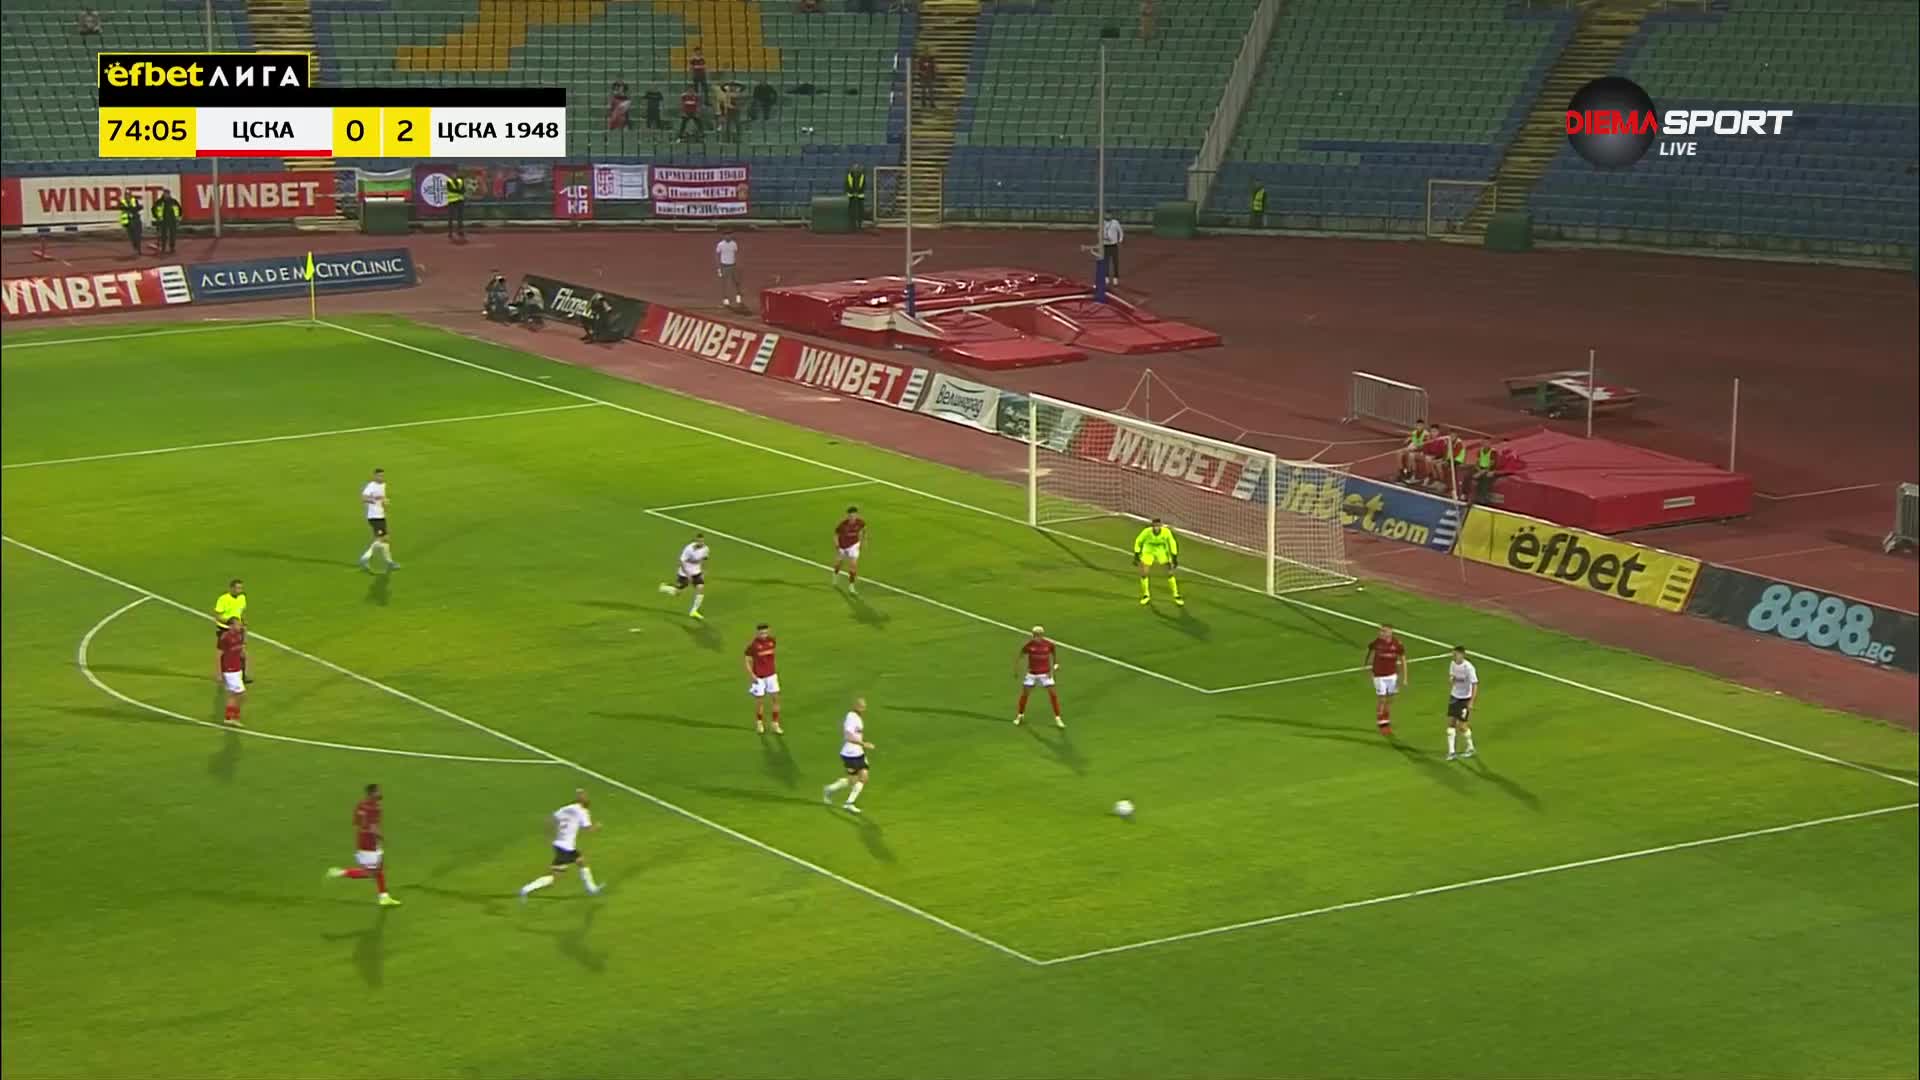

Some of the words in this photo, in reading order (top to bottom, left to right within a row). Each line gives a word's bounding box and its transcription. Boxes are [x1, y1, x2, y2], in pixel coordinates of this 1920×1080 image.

[197, 181, 320, 210] WINBET
[658, 311, 757, 365] WINBET
[794, 345, 903, 401] WINBET
[1107, 424, 1229, 488] WINBET
